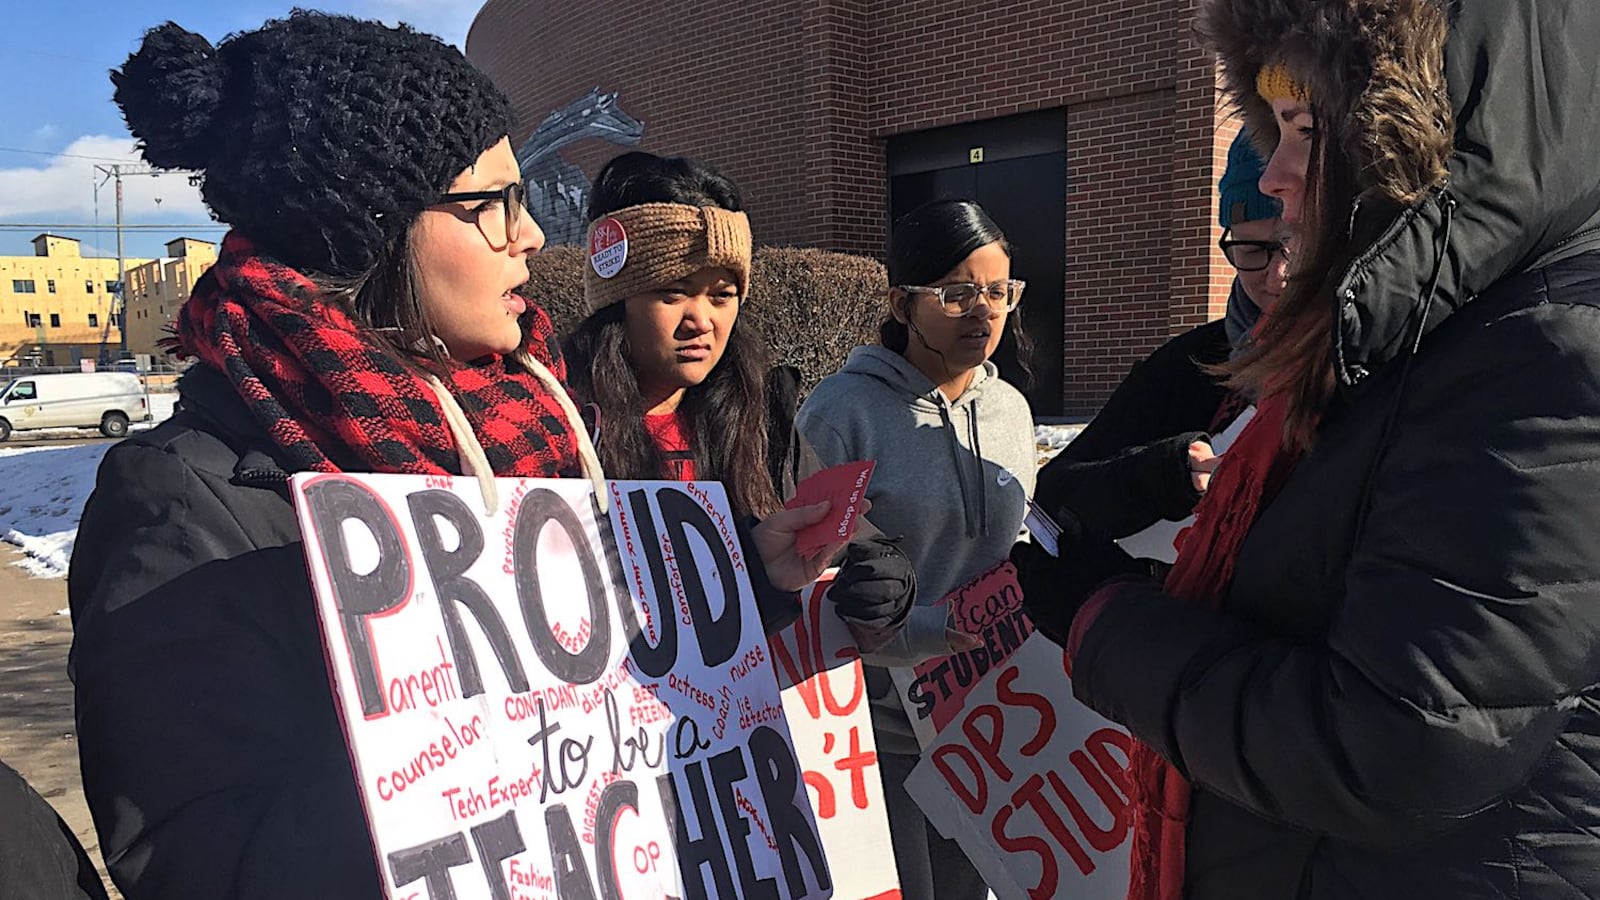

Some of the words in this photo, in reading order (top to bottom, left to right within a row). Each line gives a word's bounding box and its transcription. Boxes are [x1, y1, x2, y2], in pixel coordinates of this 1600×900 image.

[425, 476, 454, 490] chef
[849, 490, 860, 503] up
[686, 482, 745, 572] entertainer
[302, 476, 742, 717] PROUD
[661, 533, 691, 626] comforter
[969, 584, 1018, 625] can
[729, 644, 765, 683] nurse
[504, 681, 581, 722] CONFIDANT
[633, 683, 660, 703] BEST
[668, 673, 716, 712] actress
[712, 685, 734, 740] coach
[736, 695, 751, 717] lie
[629, 701, 672, 727] FRIEND
[739, 701, 783, 731] detector
[376, 714, 484, 801] counselor
[527, 697, 594, 805] to
[604, 687, 664, 776] be
[674, 715, 711, 759] a
[931, 665, 1056, 816] DPS
[441, 787, 487, 821] Tech
[488, 762, 543, 809] Expert
[582, 778, 599, 845] BIGGEST
[387, 725, 830, 900] TEACHER
[510, 858, 553, 893] Fashion
